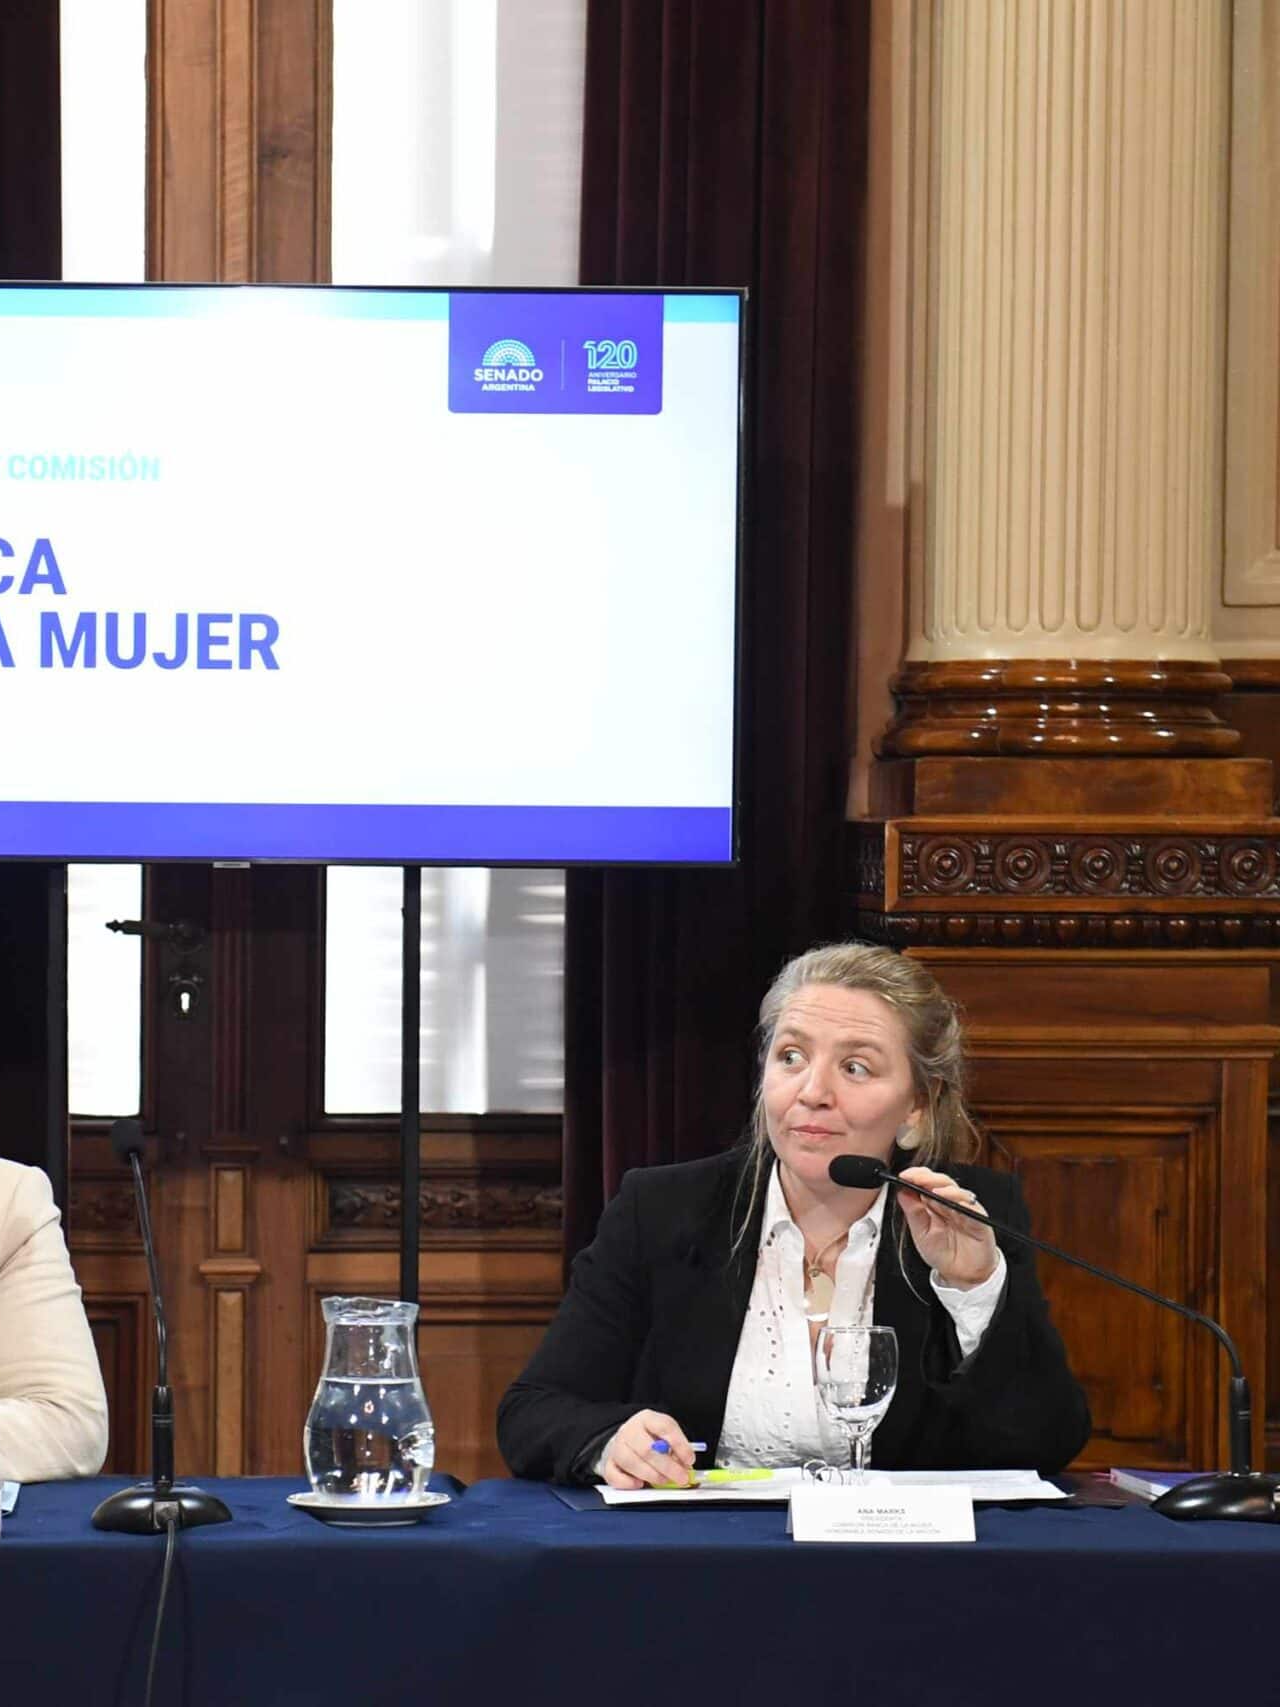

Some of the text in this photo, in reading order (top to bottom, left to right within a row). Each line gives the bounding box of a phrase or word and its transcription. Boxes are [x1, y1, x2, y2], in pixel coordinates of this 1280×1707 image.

[583, 339, 638, 370] 120
[473, 368, 544, 382] SENADO
[481, 383, 536, 392] ARGENTINA
[7, 452, 162, 482] COMISIÓN
[39, 611, 280, 671] MUJER
